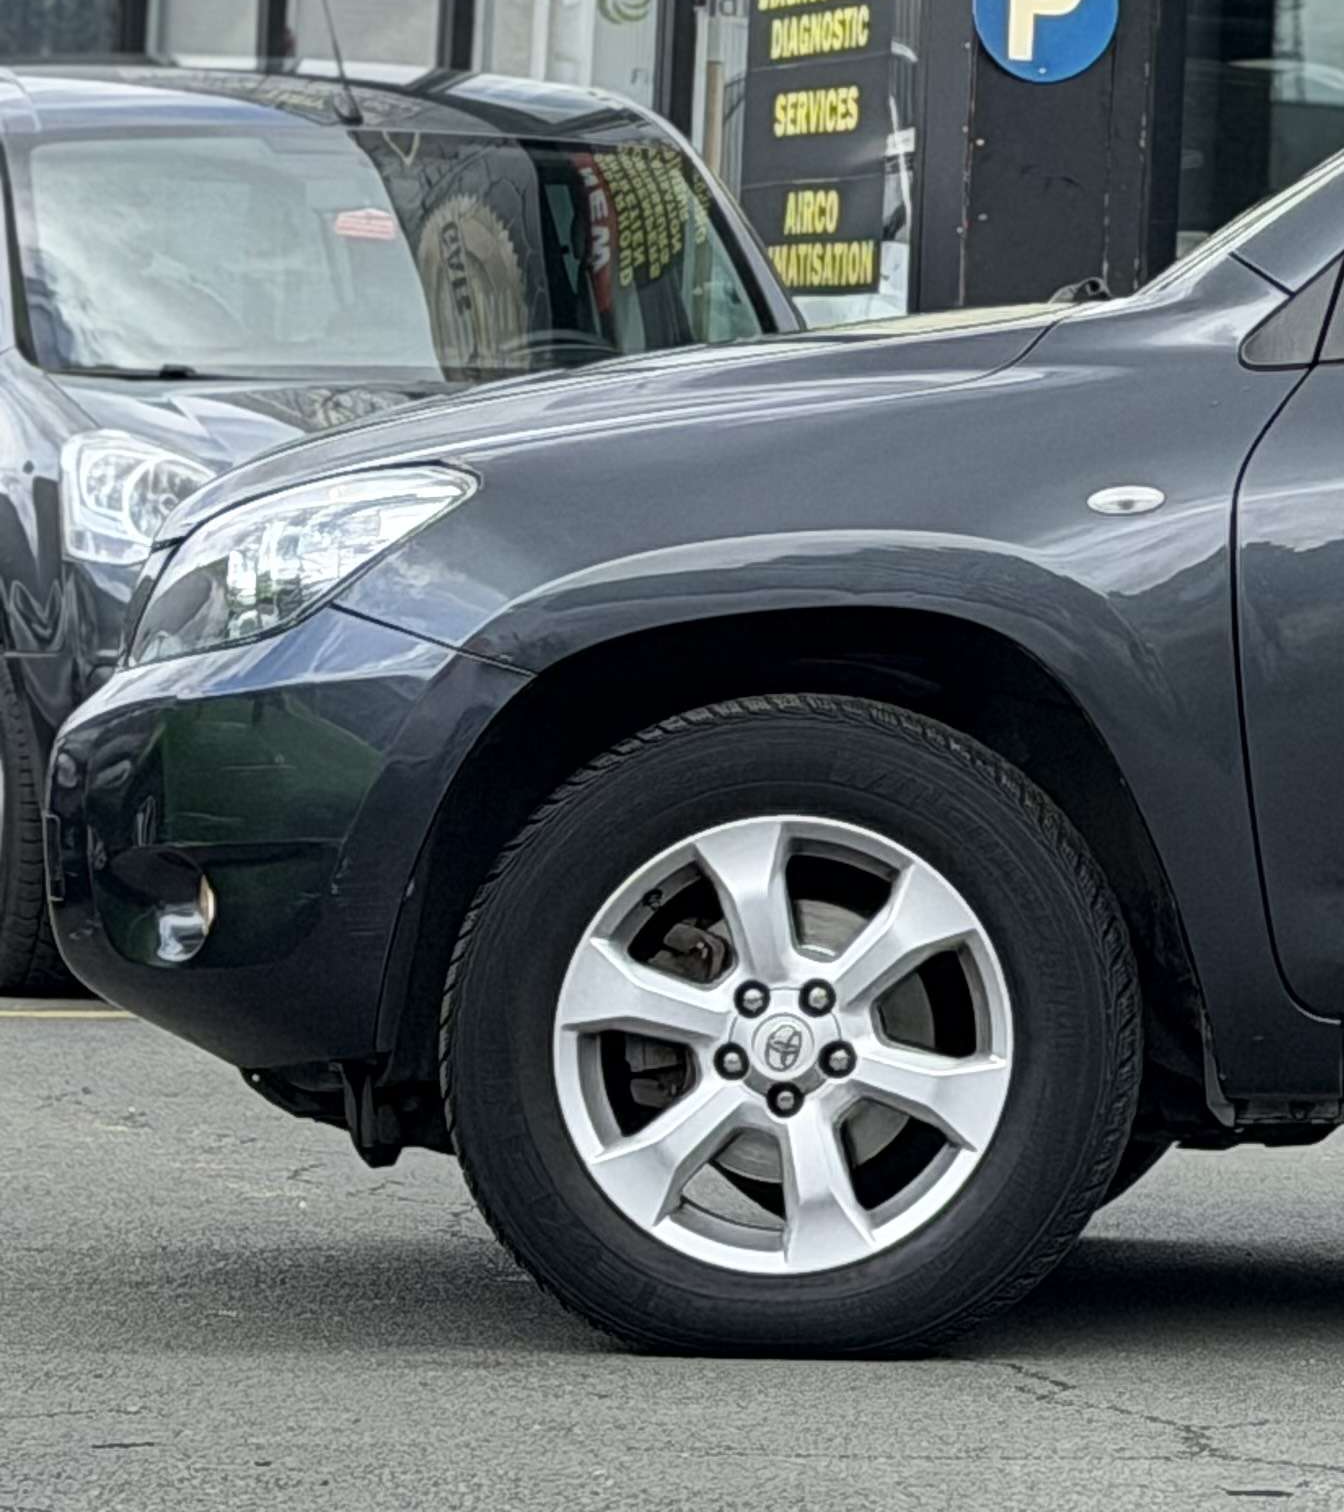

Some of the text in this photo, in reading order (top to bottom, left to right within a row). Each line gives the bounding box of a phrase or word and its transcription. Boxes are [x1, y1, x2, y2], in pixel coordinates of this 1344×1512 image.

[770, 5, 870, 60] DIAGNOSTIC
[773, 86, 860, 138] SERVICES
[783, 190, 840, 236] AIRCO
